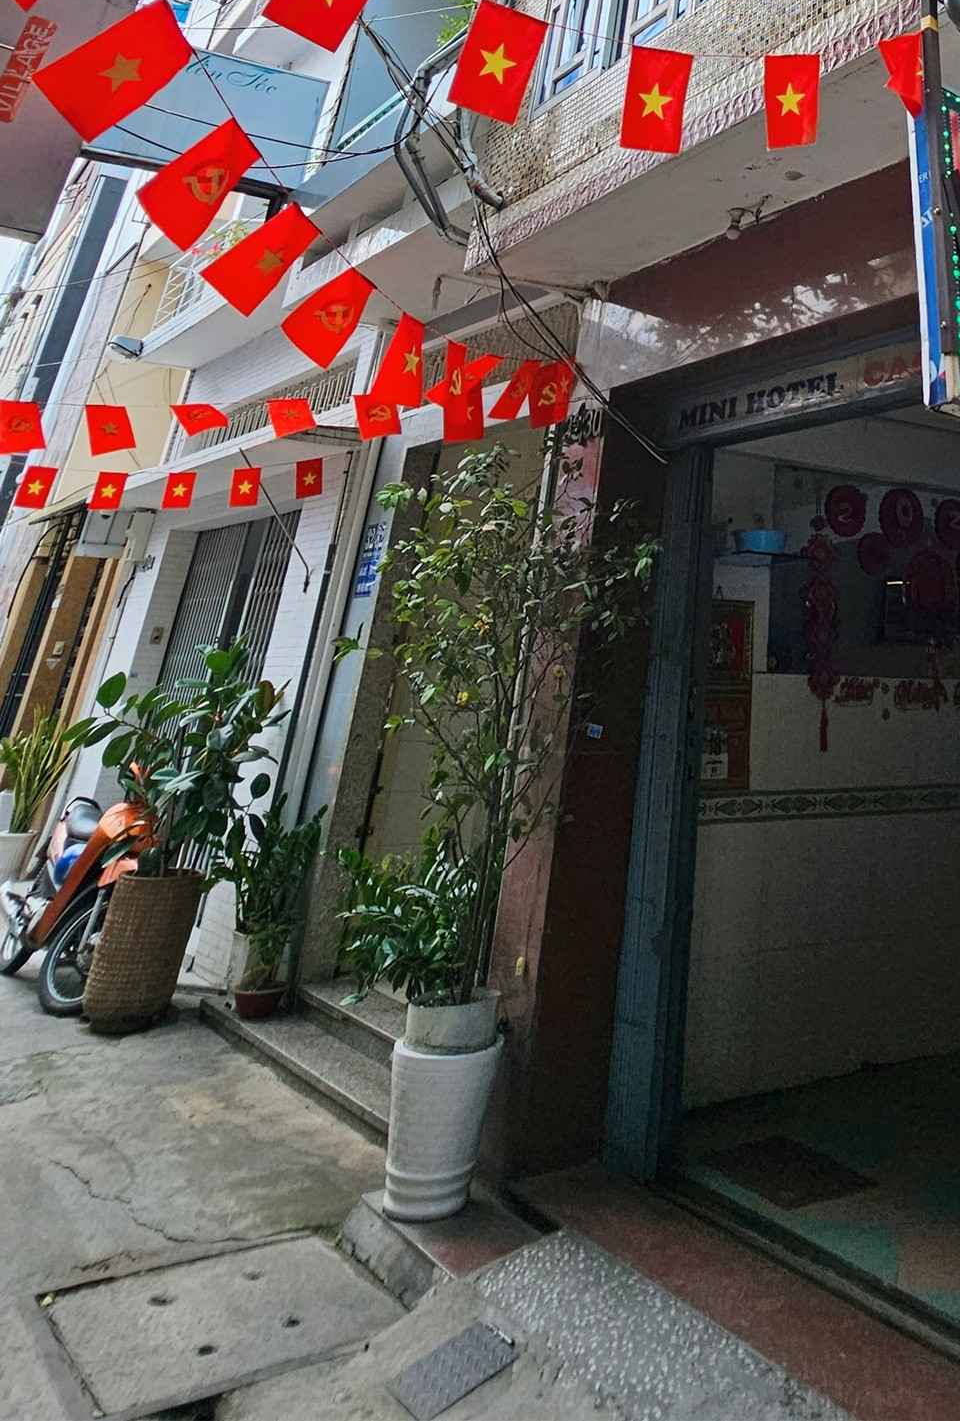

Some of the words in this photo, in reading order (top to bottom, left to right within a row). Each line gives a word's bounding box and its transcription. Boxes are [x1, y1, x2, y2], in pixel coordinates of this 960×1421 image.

[0, 24, 49, 113] VILLAGE
[679, 397, 738, 430] MINI
[745, 372, 844, 416] HOTEL
